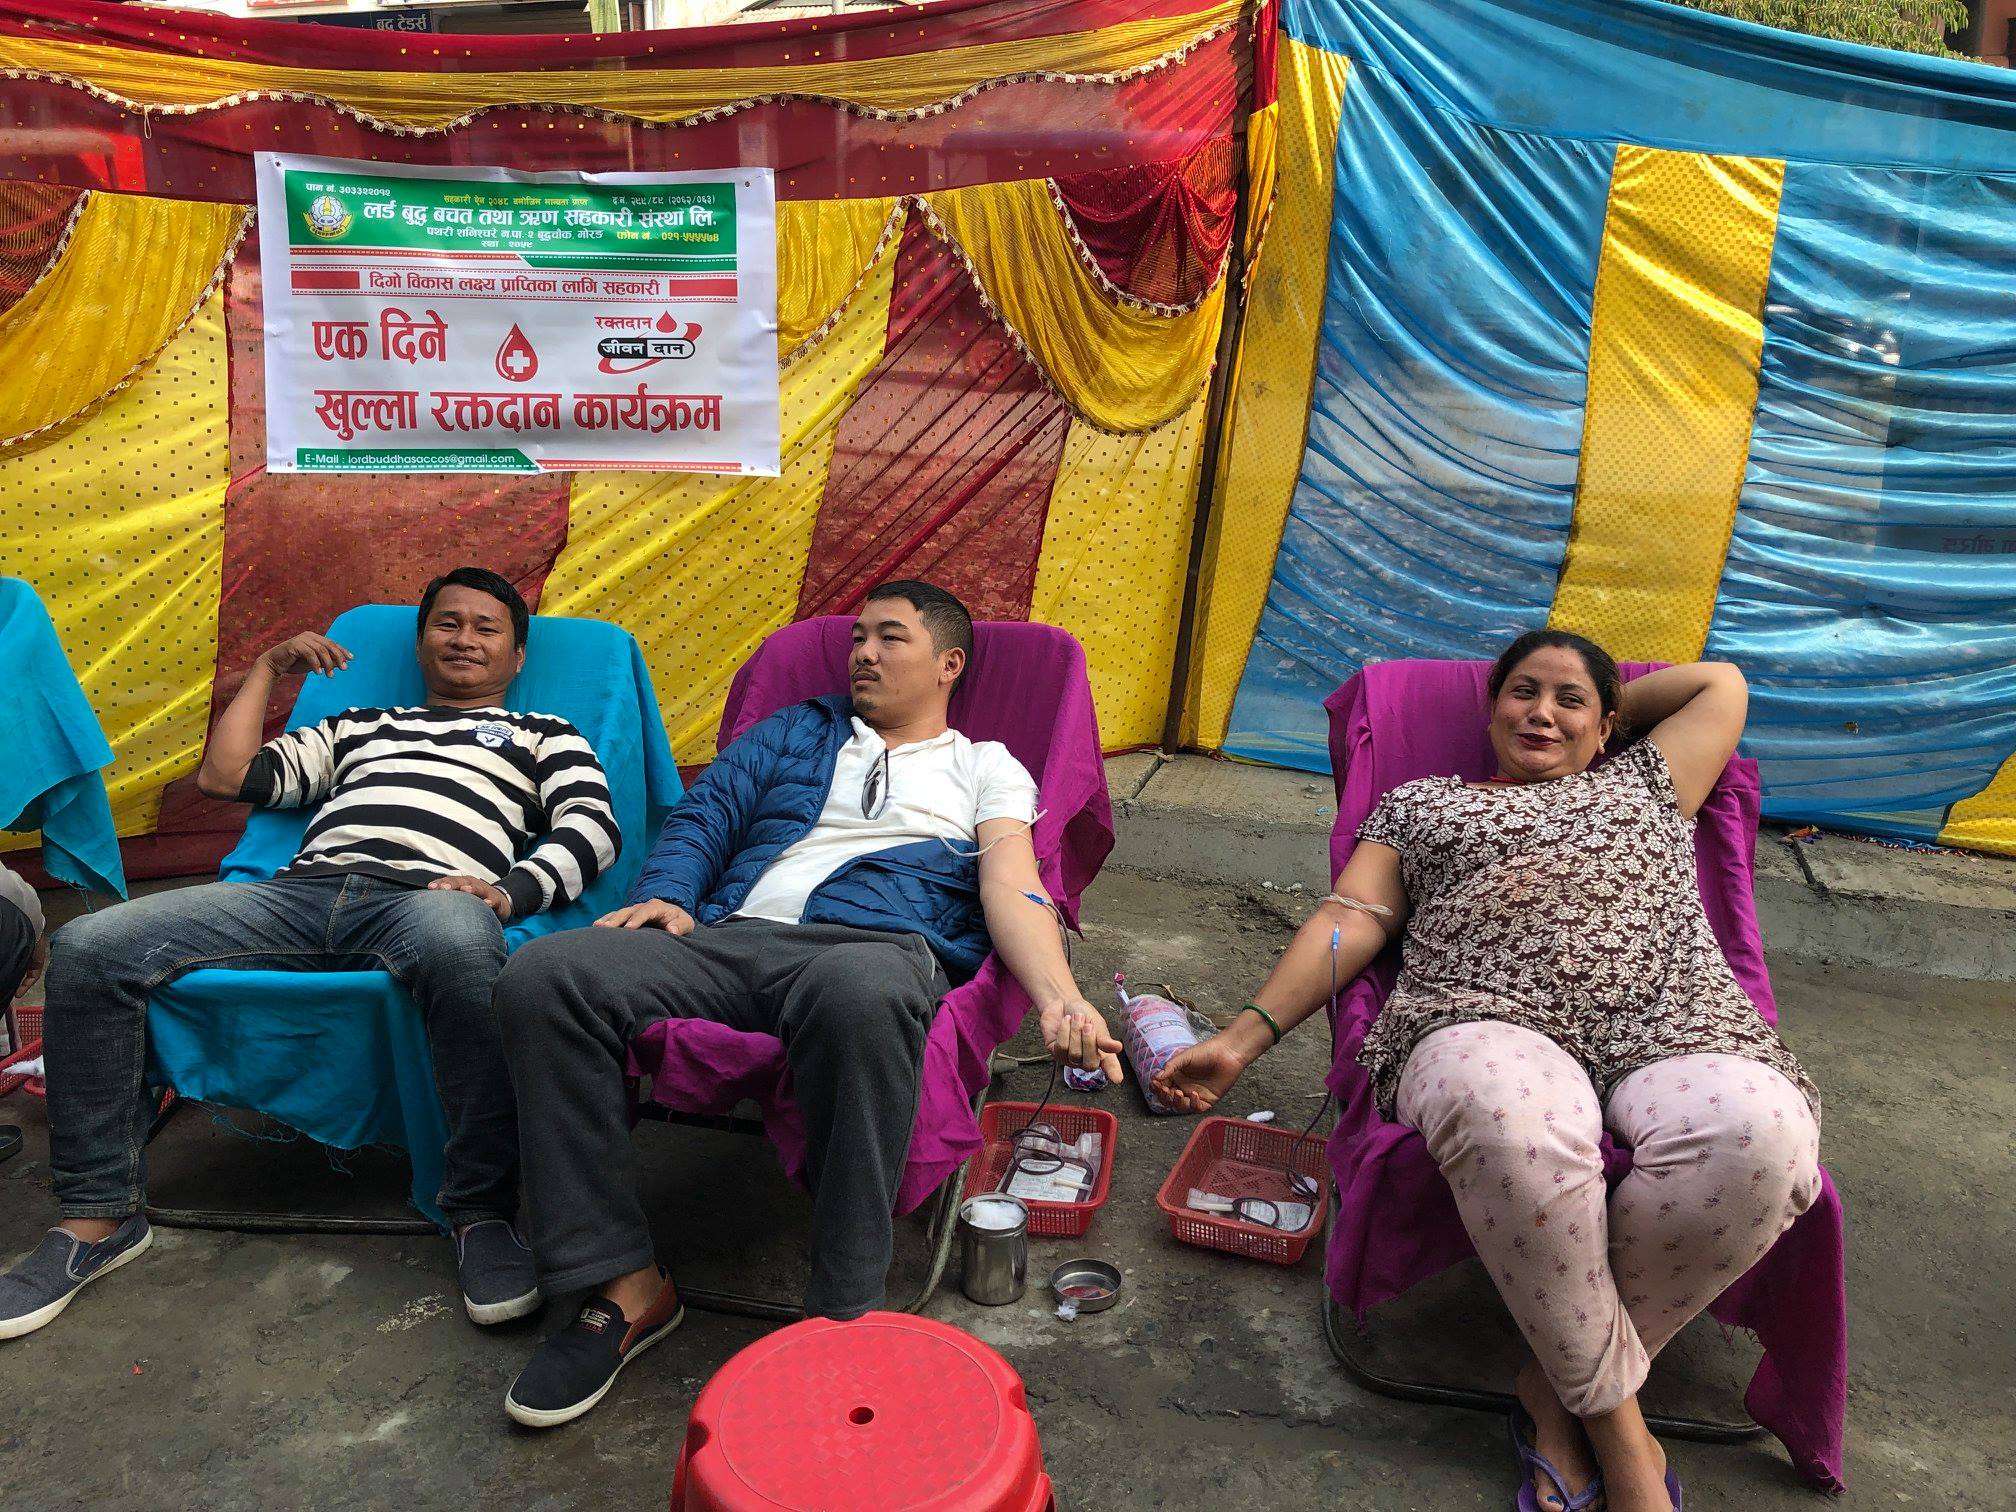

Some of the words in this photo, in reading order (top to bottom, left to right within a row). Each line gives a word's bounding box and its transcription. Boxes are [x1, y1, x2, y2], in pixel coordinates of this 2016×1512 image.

[363, 200, 398, 220] लर्ड
[402, 204, 428, 227] बुद्ध
[433, 207, 473, 225] बचत
[478, 208, 514, 226] तथा
[519, 210, 559, 226] ऋण
[564, 207, 633, 228] सहकारी
[638, 207, 685, 229] संस्था
[690, 204, 718, 228] लि.
[426, 226, 453, 237] पथरी
[370, 271, 402, 289] दिगो
[407, 272, 454, 291] विकास
[459, 277, 496, 293] लक्ष्य
[501, 275, 557, 294] प्राप्तिका
[562, 276, 598, 294] लागि
[602, 279, 661, 296] सहकारी
[595, 316, 654, 331] रक्तदान
[312, 321, 369, 360] एक
[379, 307, 449, 366] दिने
[602, 338, 645, 357] जीवन
[652, 340, 686, 357] दान
[313, 388, 420, 442] खुल्ला
[429, 390, 563, 434] रक्तदान
[573, 382, 724, 434] कार्यक्रम
[304, 454, 339, 464] E-Mail
[347, 454, 516, 466] lordbuddhasaccos@gmail.com
